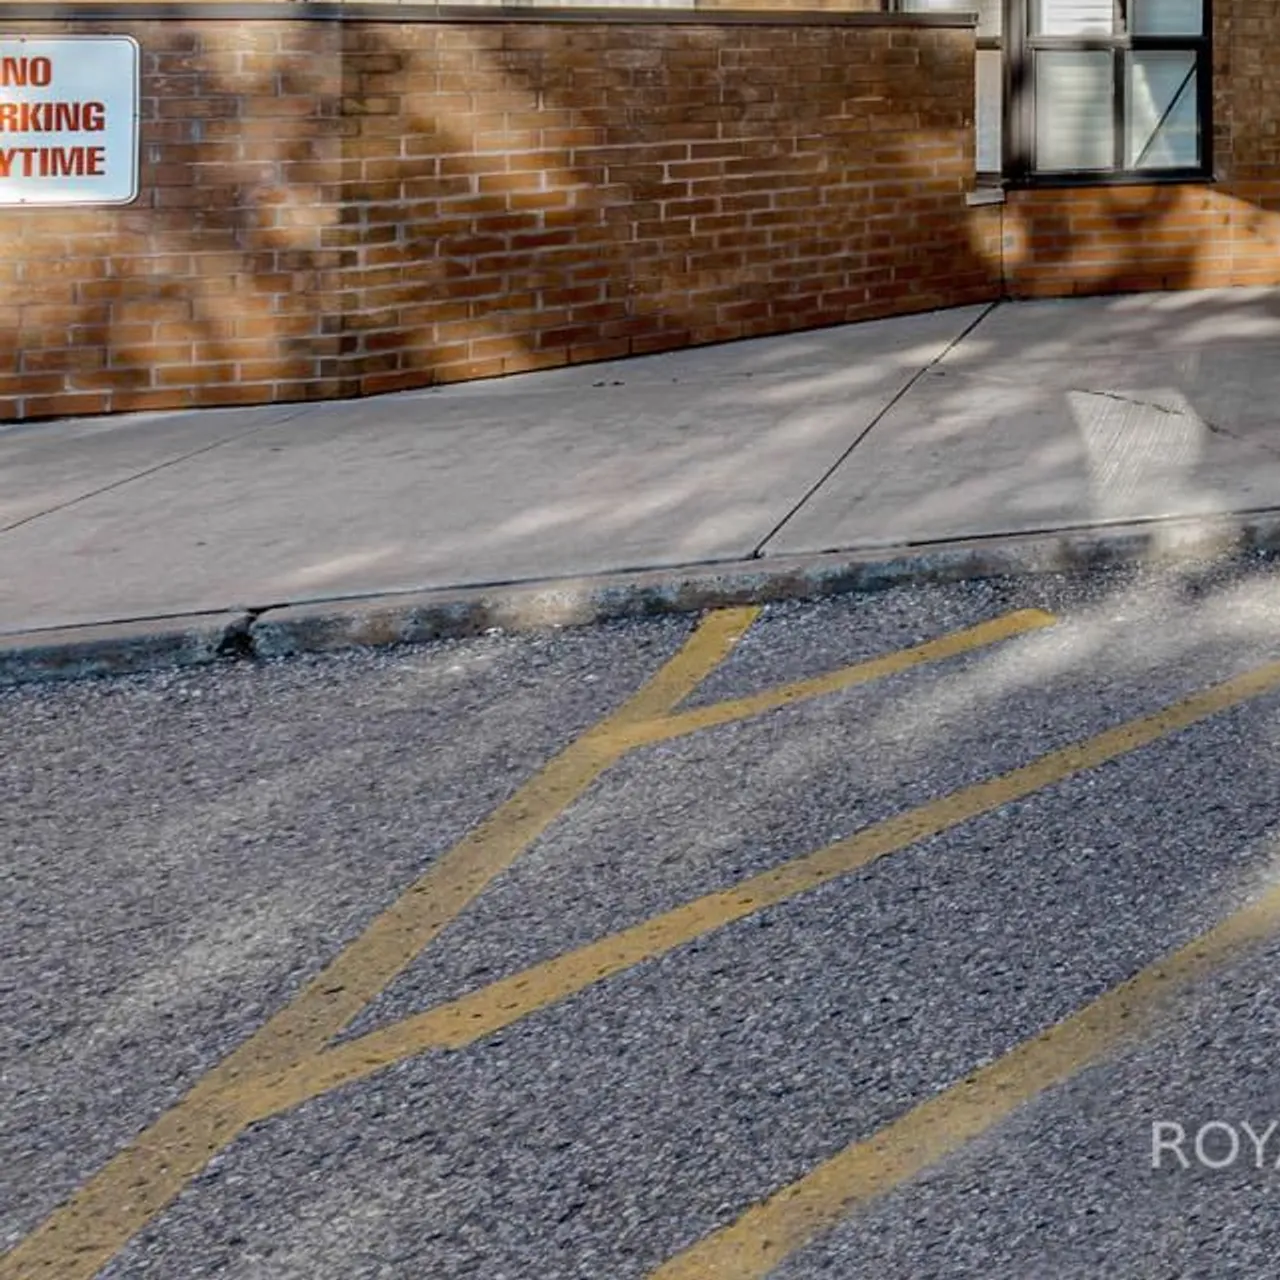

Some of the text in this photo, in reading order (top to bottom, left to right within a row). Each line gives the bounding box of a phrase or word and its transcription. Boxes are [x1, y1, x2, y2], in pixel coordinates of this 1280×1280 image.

[1, 56, 52, 87] NO
[0, 102, 105, 132] RKING
[0, 146, 105, 177] YTIME
